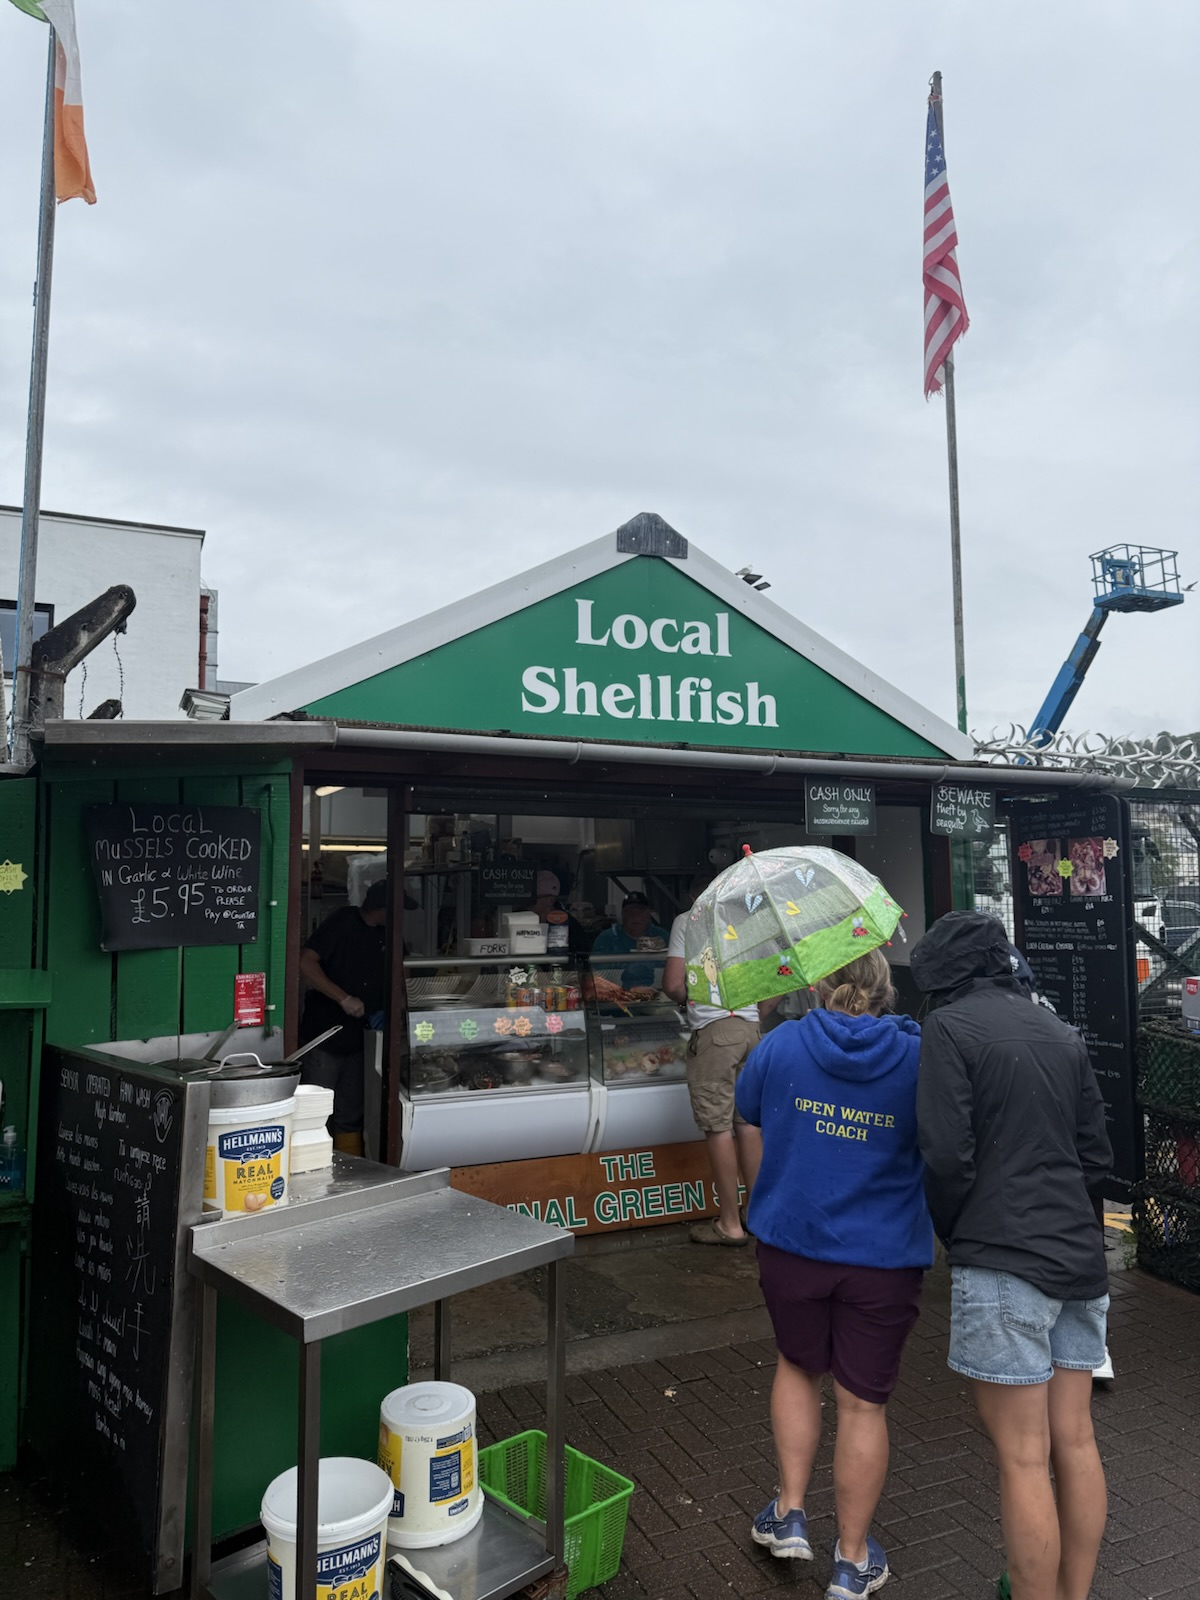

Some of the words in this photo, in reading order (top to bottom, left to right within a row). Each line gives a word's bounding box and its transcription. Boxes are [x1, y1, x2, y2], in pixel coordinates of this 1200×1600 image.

[575, 598, 732, 657] Local
[521, 665, 779, 727] Shellfish
[809, 786, 839, 801] CASH
[843, 787, 871, 802] ONLY
[937, 785, 991, 808] BEWARE
[822, 804, 840, 818] Sorry
[839, 803, 848, 817] for
[848, 806, 859, 818] any
[936, 803, 956, 816] theft
[957, 803, 967, 824] by
[935, 818, 964, 834] seagulls
[101, 870, 113, 887] IN
[118, 862, 157, 885] Garlic
[176, 864, 209, 881] White
[211, 865, 243, 880] Wine
[482, 869, 508, 880] CASH
[511, 869, 535, 880] ONLY
[130, 882, 206, 924] £5.95
[479, 943, 507, 954] FORKS
[60, 1068, 80, 1094] SENSOR
[86, 1074, 111, 1098] OPERATED
[119, 1080, 135, 1104] HAND
[134, 1086, 152, 1109] WASH
[795, 1097, 836, 1117] OPEN
[840, 1106, 895, 1128] WATER
[223, 1128, 283, 1151] HELLMANN'S
[815, 1120, 868, 1142] COACH
[236, 1163, 273, 1179] REAL
[600, 1151, 656, 1182] THE
[233, 1174, 274, 1185] MAYONNAISE
[593, 1180, 706, 1224] GREEN
